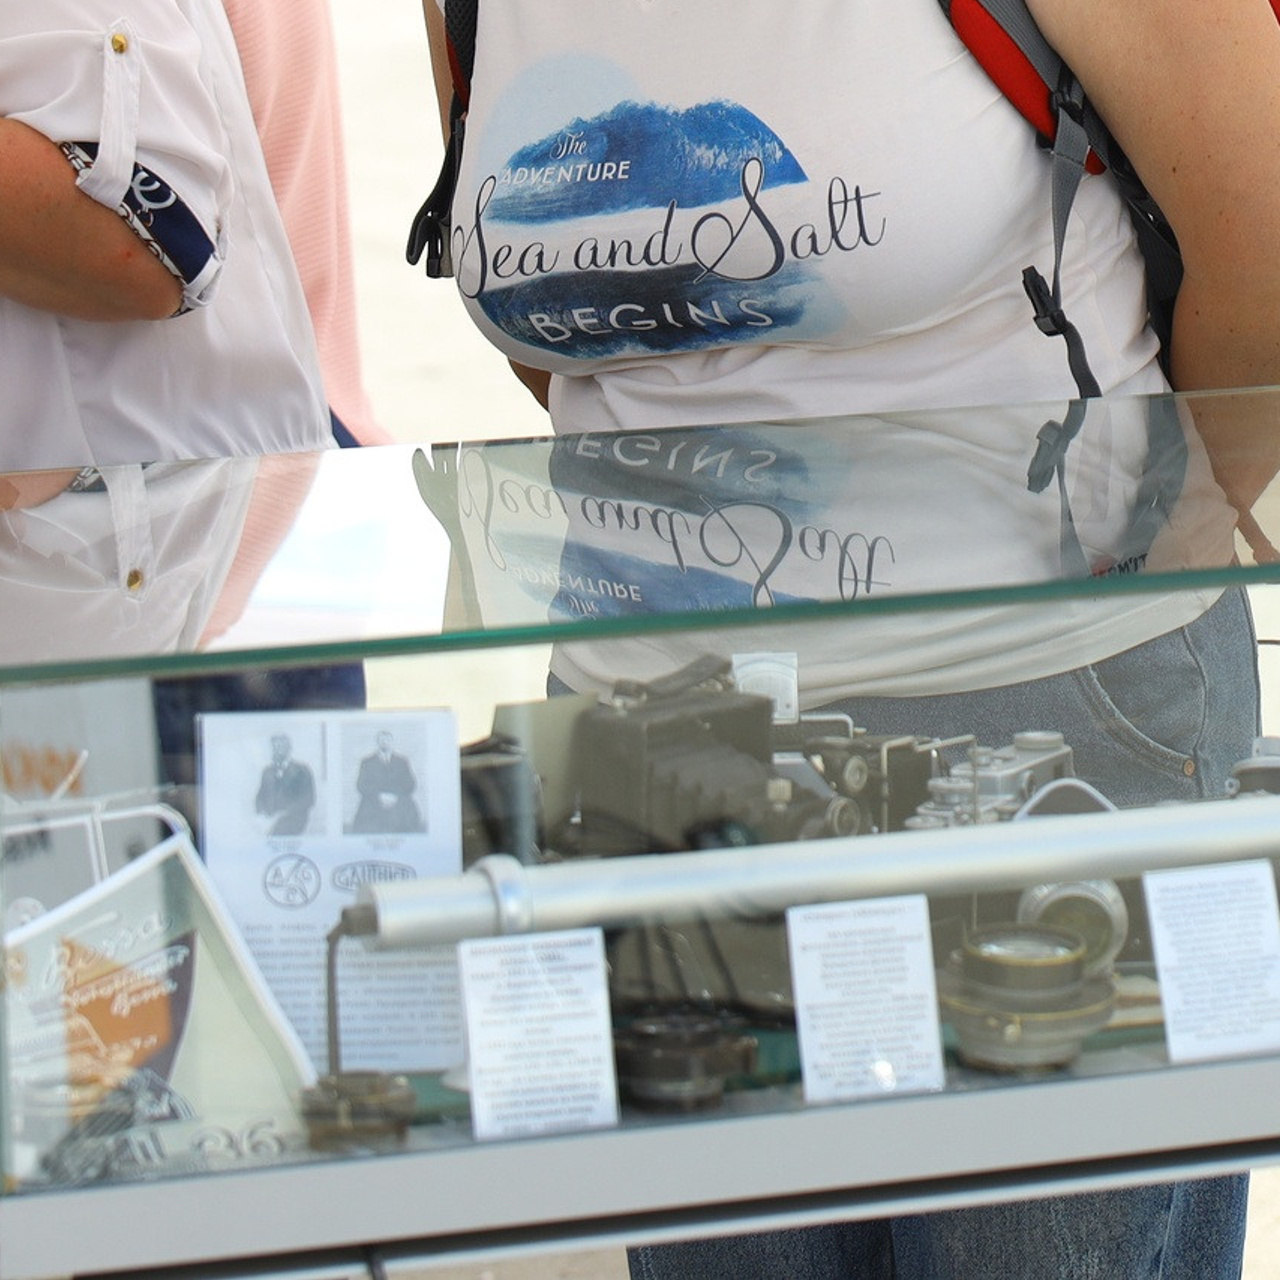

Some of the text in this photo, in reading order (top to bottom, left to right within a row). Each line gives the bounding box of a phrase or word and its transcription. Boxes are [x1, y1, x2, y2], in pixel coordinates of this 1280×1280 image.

[550, 130, 588, 160] The
[500, 160, 632, 186] ADVENTURE
[452, 157, 887, 299] Sea and Salt
[528, 297, 774, 343] BEGINS
